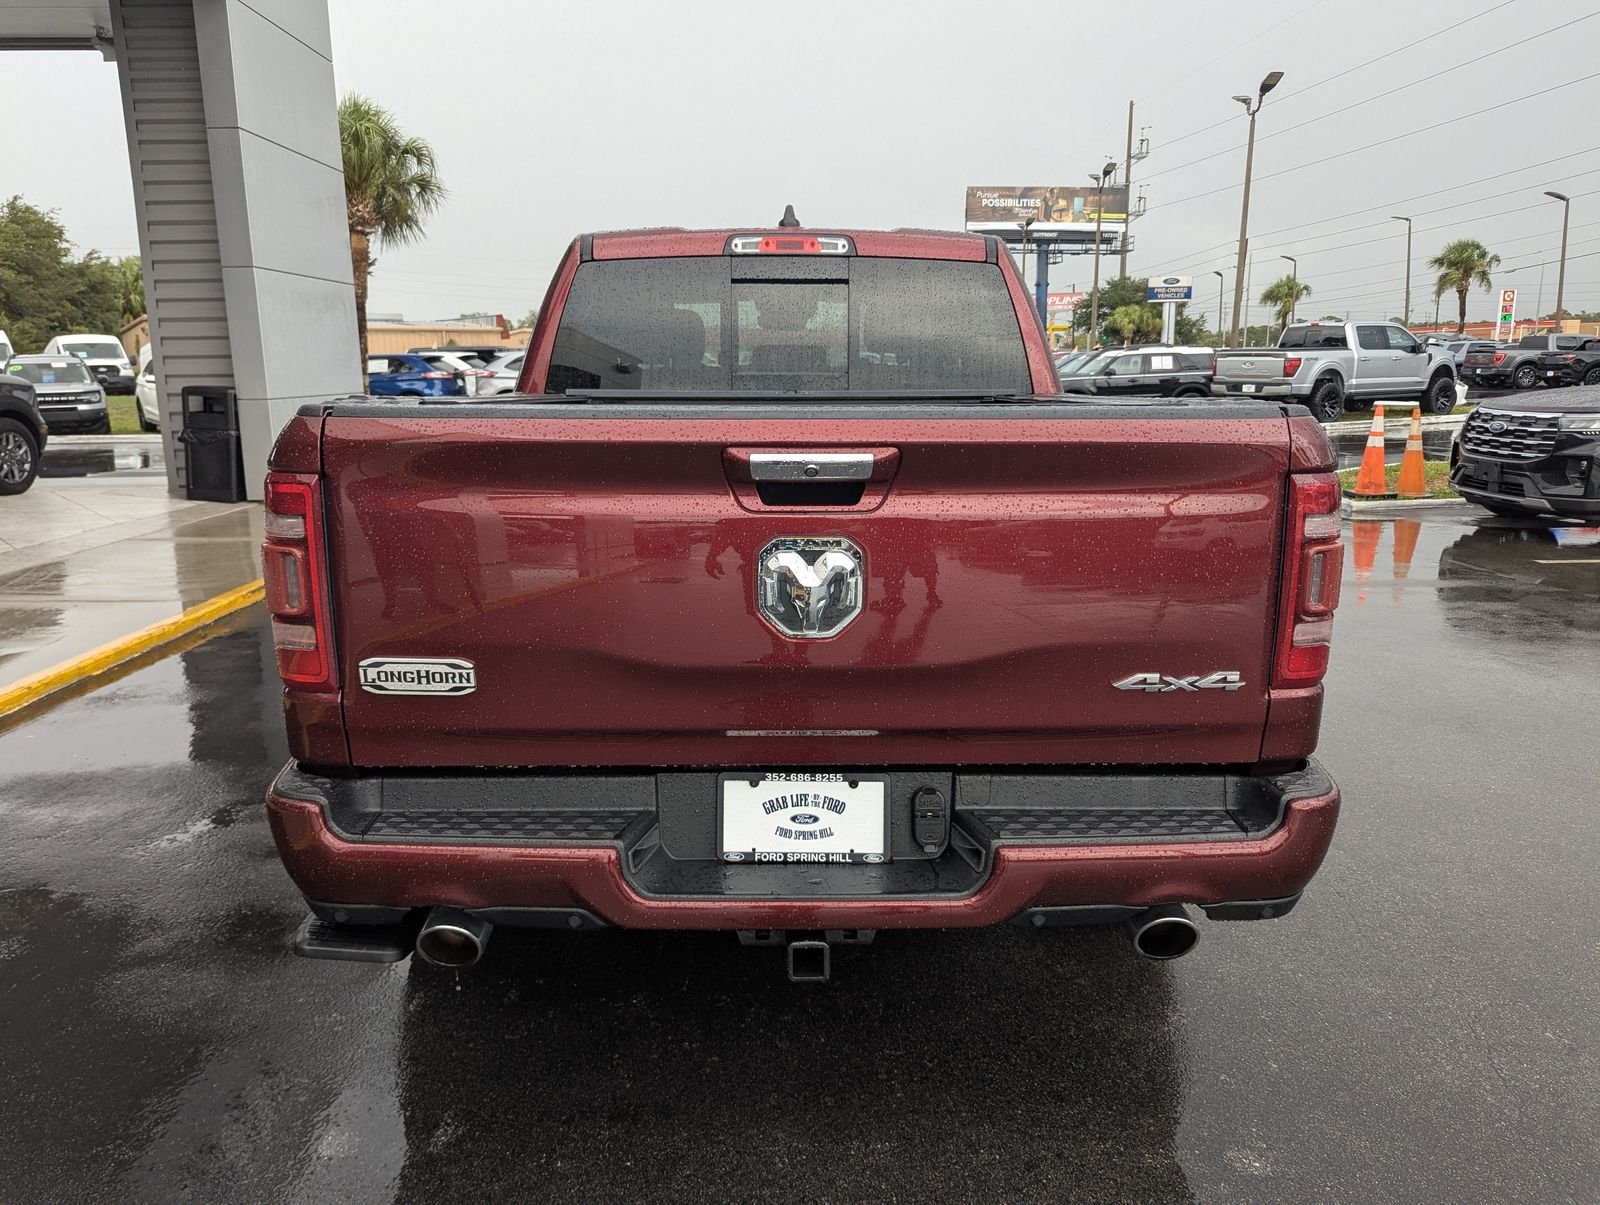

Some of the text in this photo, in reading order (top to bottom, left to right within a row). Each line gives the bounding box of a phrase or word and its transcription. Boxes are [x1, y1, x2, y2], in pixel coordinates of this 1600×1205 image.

[976, 190, 999, 198] Pursue
[981, 198, 1041, 207] POSSIBILITIES
[779, 540, 843, 549] RAM
[361, 668, 473, 685] LONGHORN
[765, 773, 843, 782] 352-686-8255
[762, 793, 810, 815] GRAB LIFE
[821, 795, 847, 815] FORD
[774, 826, 835, 841] FORD SPRING HILL
[754, 853, 852, 862] FORD SPRING HILL
